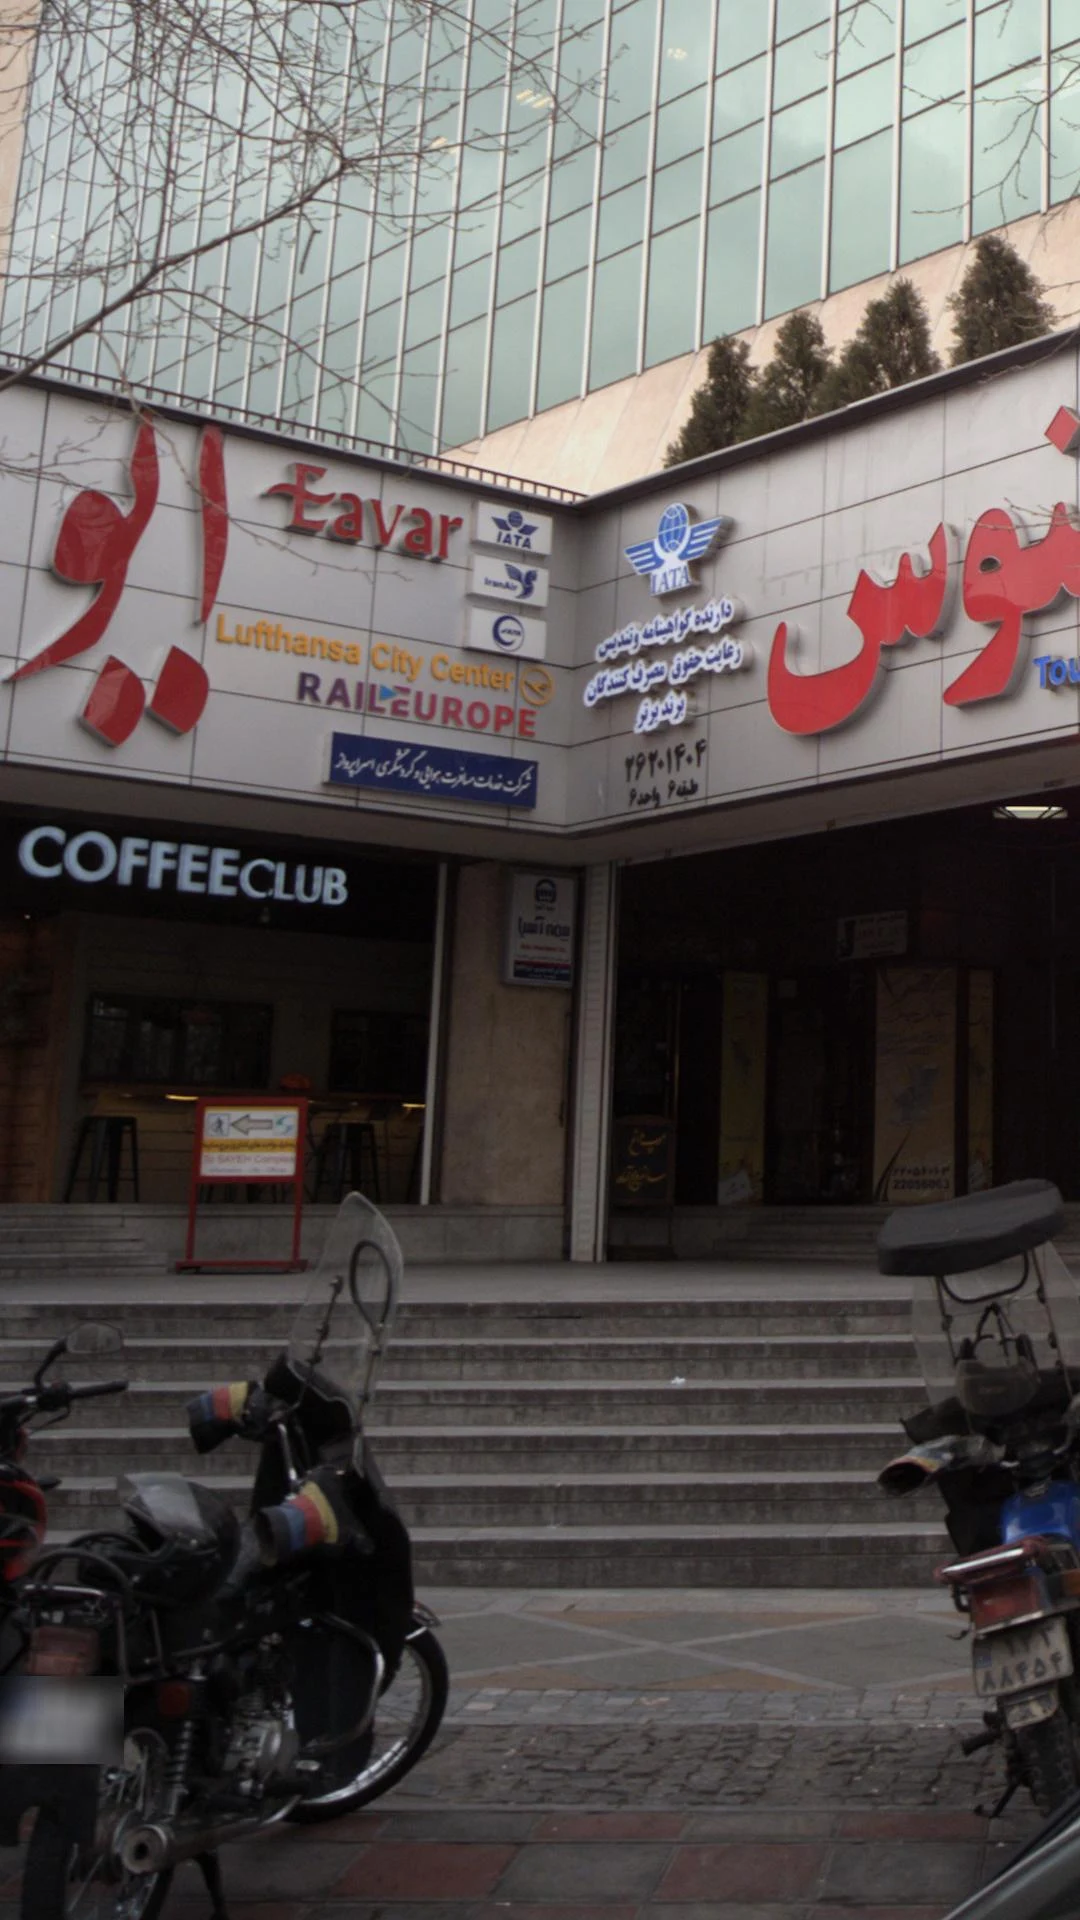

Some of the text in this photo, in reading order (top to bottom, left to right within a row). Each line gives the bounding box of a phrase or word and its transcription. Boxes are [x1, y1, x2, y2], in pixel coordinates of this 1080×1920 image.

[263, 462, 463, 560] Eavar
[496, 532, 532, 550] IATA
[650, 564, 690, 596] IATA
[767, 405, 1080, 735] نوس
[640, 606, 694, 643] گواهینامه
[692, 599, 734, 633] دارنده
[216, 613, 514, 692] Lufthansa City Center
[584, 638, 743, 706] رعایت حقوق مصرف کنندگان
[634, 690, 688, 733] برند برتر
[440, 765, 475, 789] مسافرت
[624, 738, 708, 783] ۲۶۲۰۱۴۰۴
[473, 772, 504, 791] خدمات
[503, 764, 534, 797] شرکت
